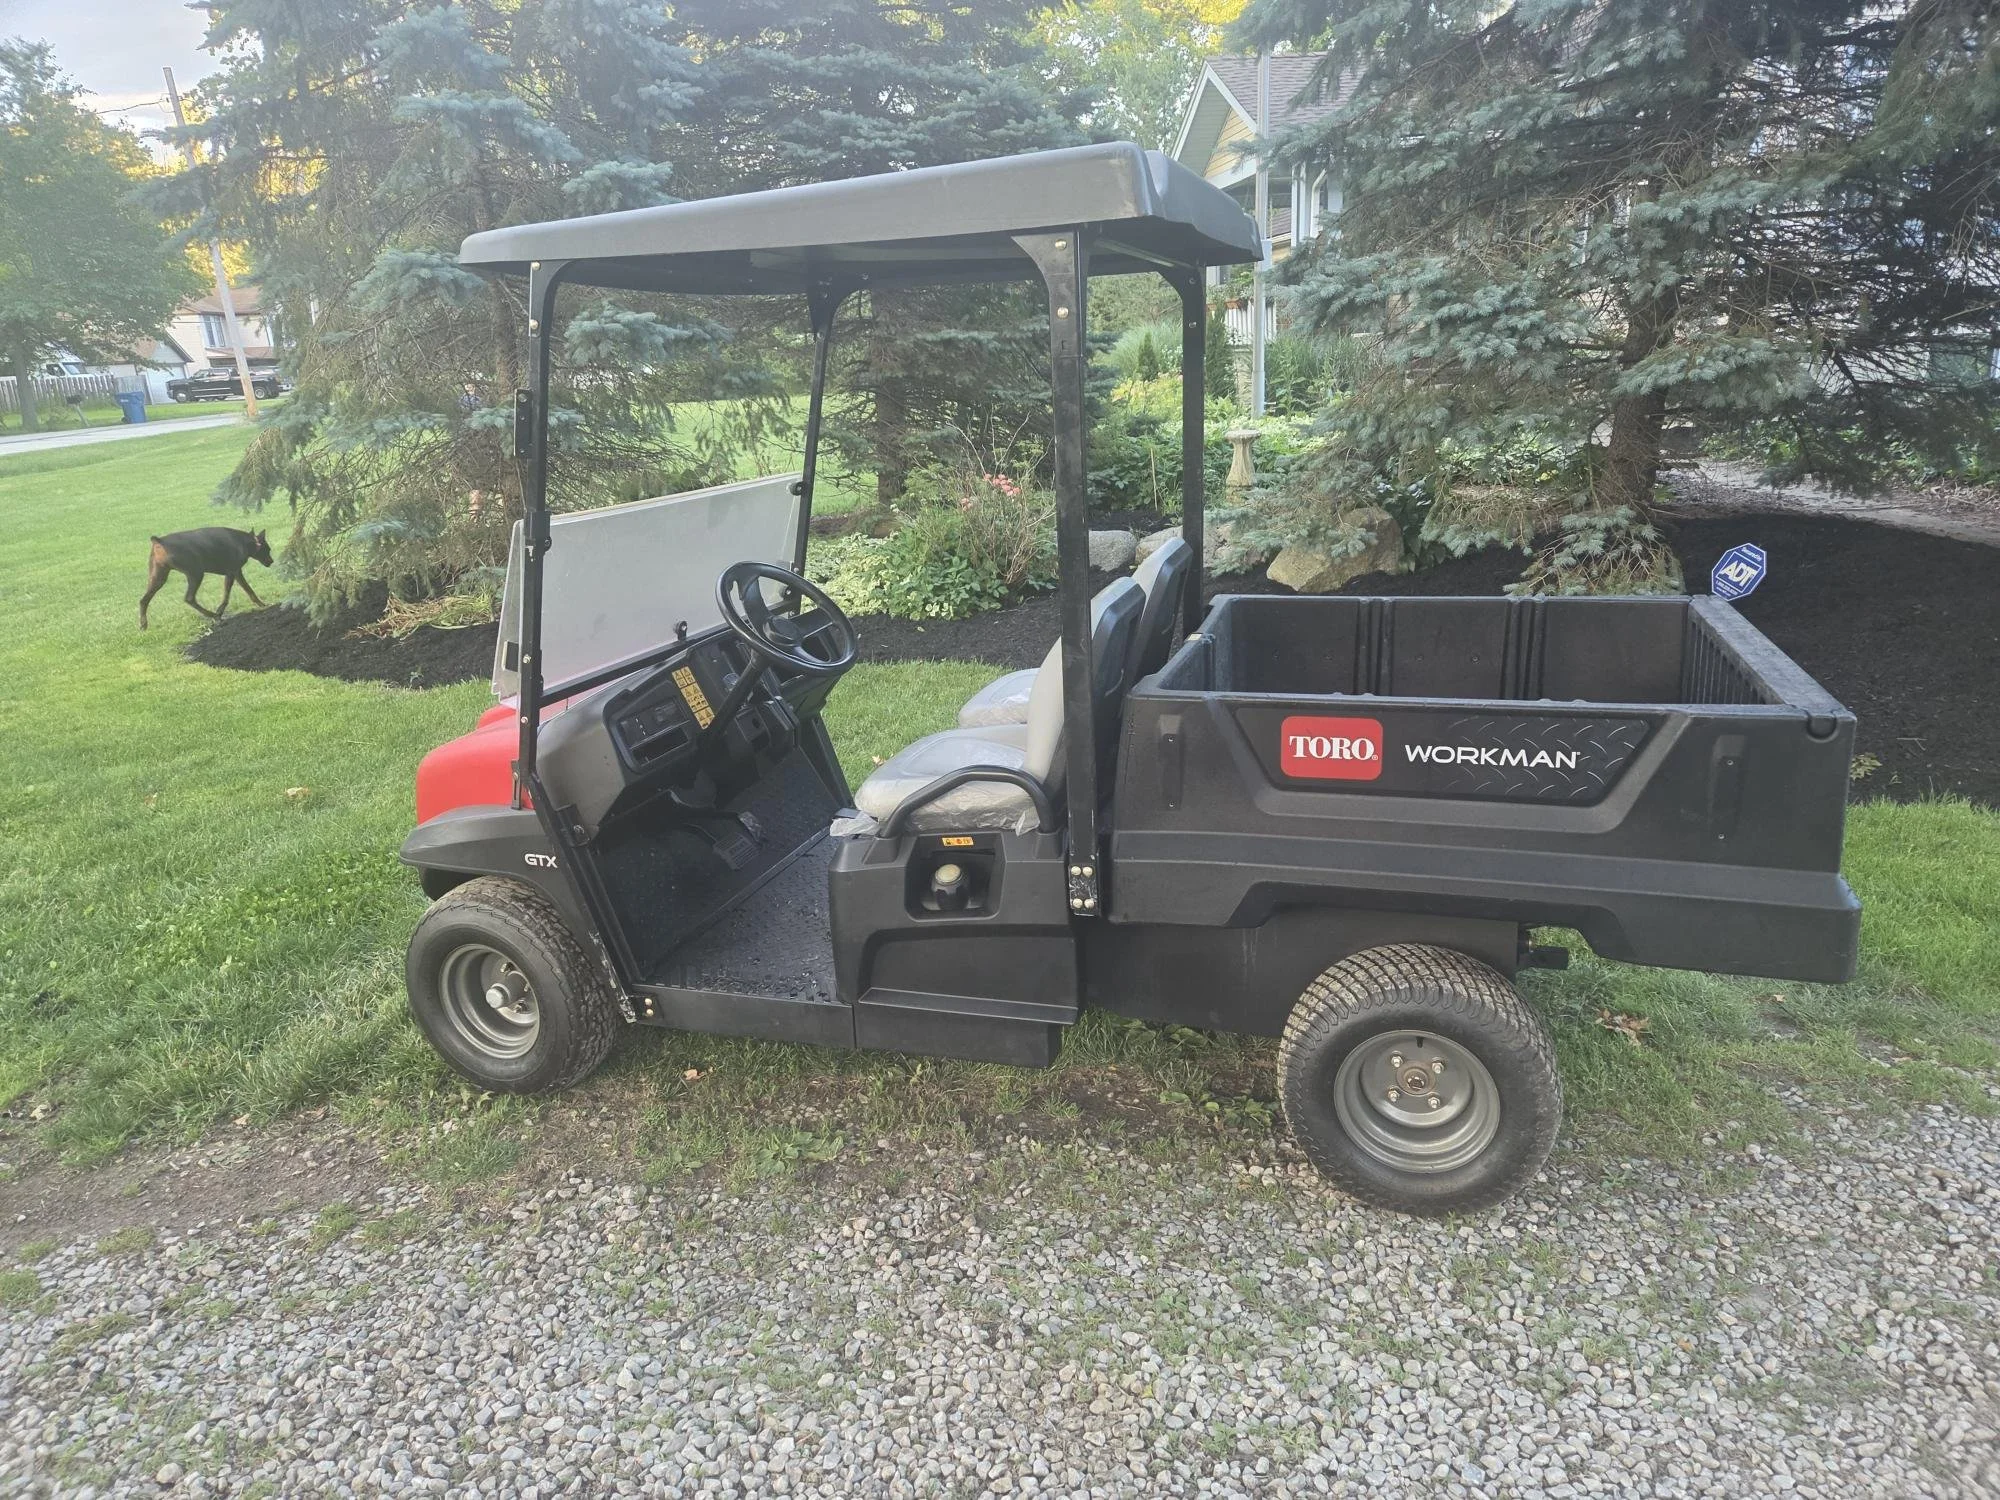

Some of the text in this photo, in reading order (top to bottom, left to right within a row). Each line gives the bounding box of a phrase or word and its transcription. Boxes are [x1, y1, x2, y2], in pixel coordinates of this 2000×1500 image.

[1719, 560, 1759, 587] ADT
[1289, 736, 1577, 769] TORO WORKMAN
[524, 853, 558, 868] GTX
